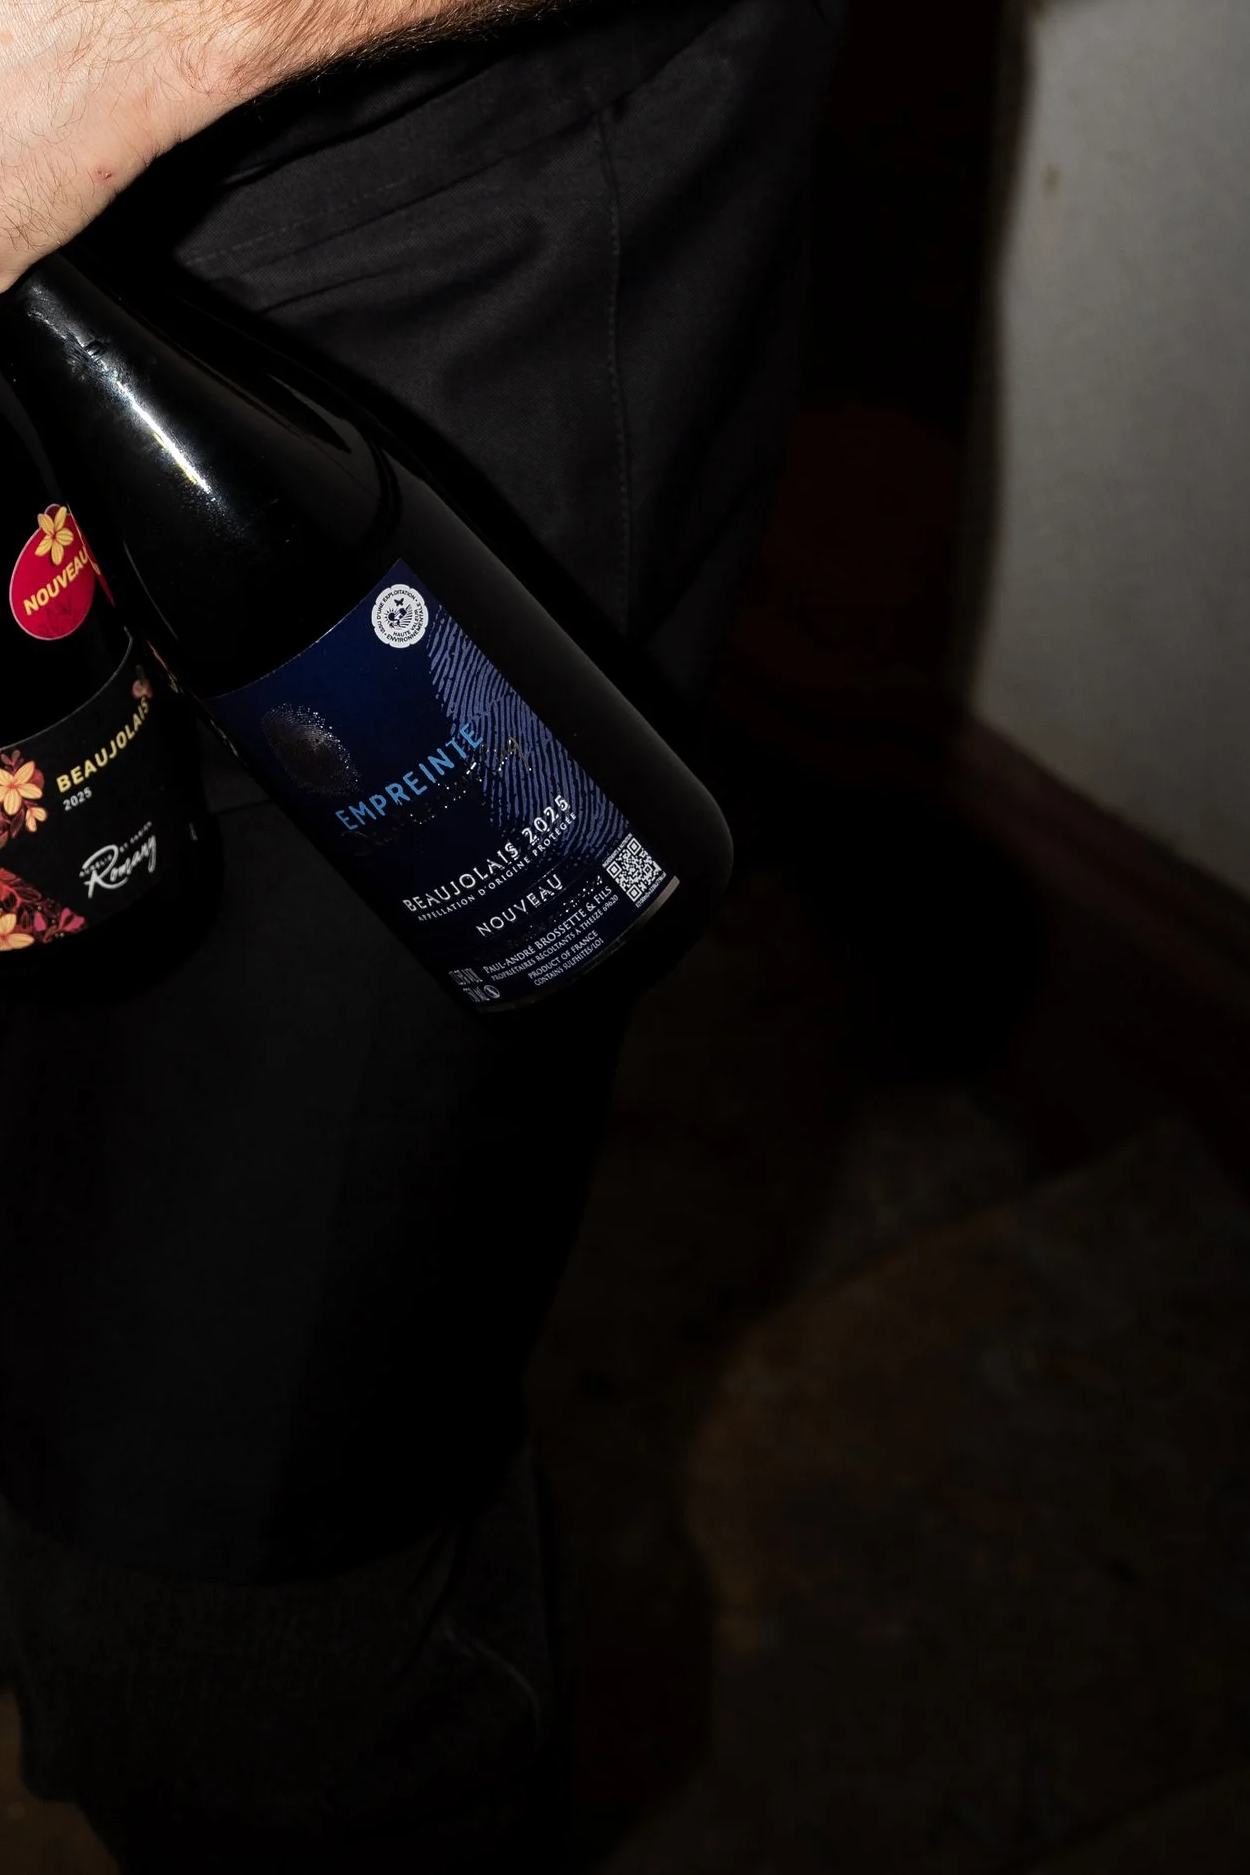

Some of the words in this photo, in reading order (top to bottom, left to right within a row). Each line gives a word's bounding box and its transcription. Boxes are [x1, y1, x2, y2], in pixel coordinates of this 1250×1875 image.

[23, 548, 89, 615] NOUVEAU
[56, 696, 149, 793] BEAUJOLAIS
[335, 723, 483, 830] EMPREINTE
[63, 787, 93, 811] 2025
[402, 842, 519, 912] BEAUJOLAIS
[521, 794, 570, 845] 2025
[418, 894, 476, 922] APPELLATION
[478, 856, 530, 896] D'ORIGINE
[476, 874, 563, 936] NOUVEAU
[482, 945, 536, 974] PAUL-ANDRÉ
[534, 909, 587, 949] BROSSETTE
[585, 902, 596, 912] &
[594, 885, 613, 904] FILS
[528, 957, 561, 980] PRODUCT
[560, 948, 572, 961] OF
[570, 930, 599, 953] FRANCE
[534, 967, 564, 986] CONTAINS
